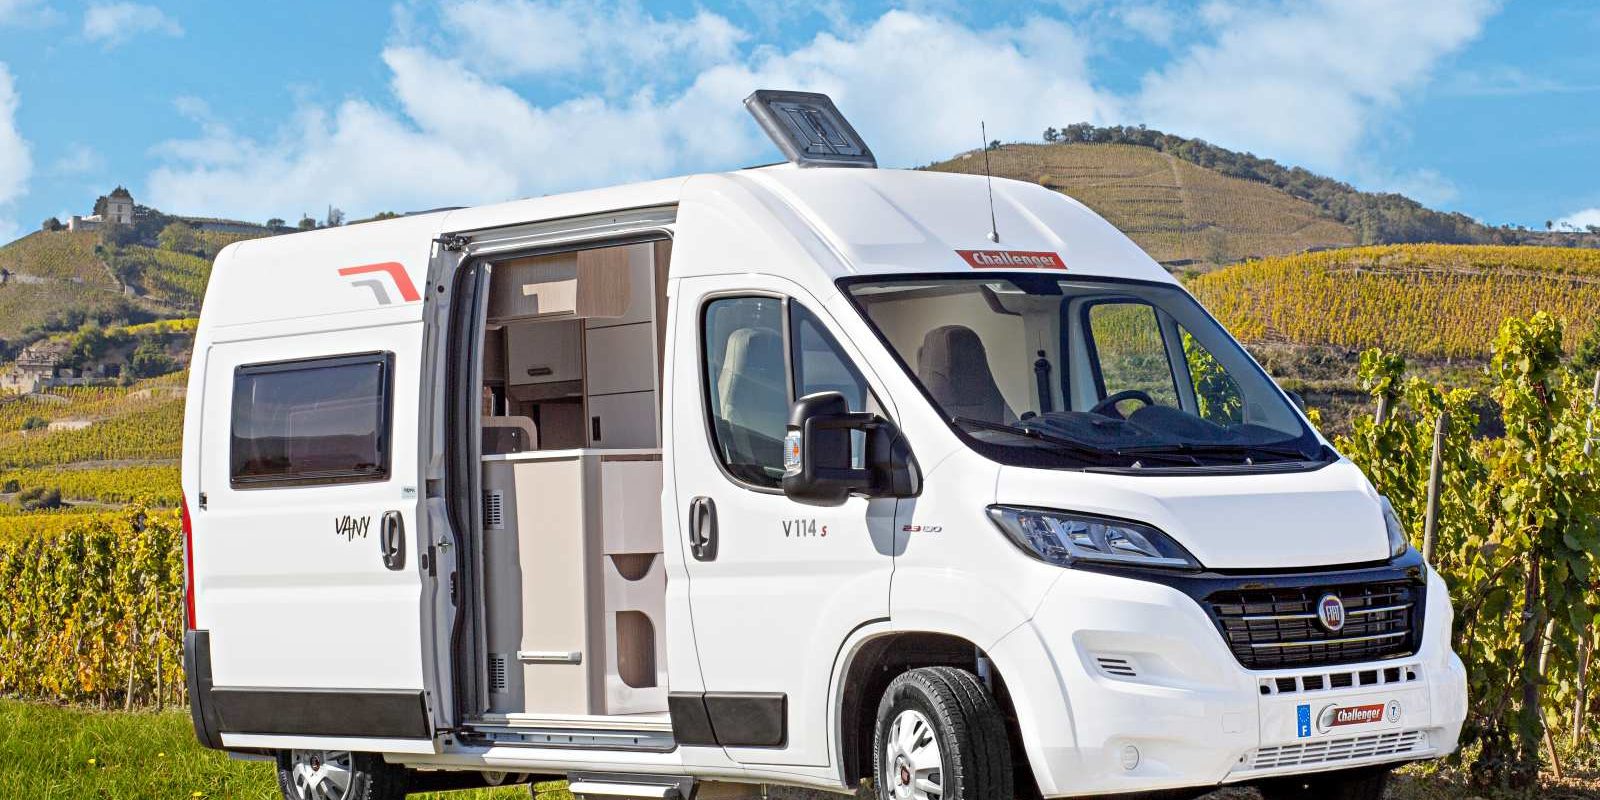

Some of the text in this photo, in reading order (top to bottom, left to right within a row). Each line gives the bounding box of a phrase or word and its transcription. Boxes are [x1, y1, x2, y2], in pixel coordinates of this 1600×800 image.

[972, 251, 1056, 268] Challenger
[335, 515, 371, 541] VANY
[1325, 605, 1339, 621] FIAT
[1337, 708, 1380, 722] Challenger
[1302, 725, 1308, 736] F
